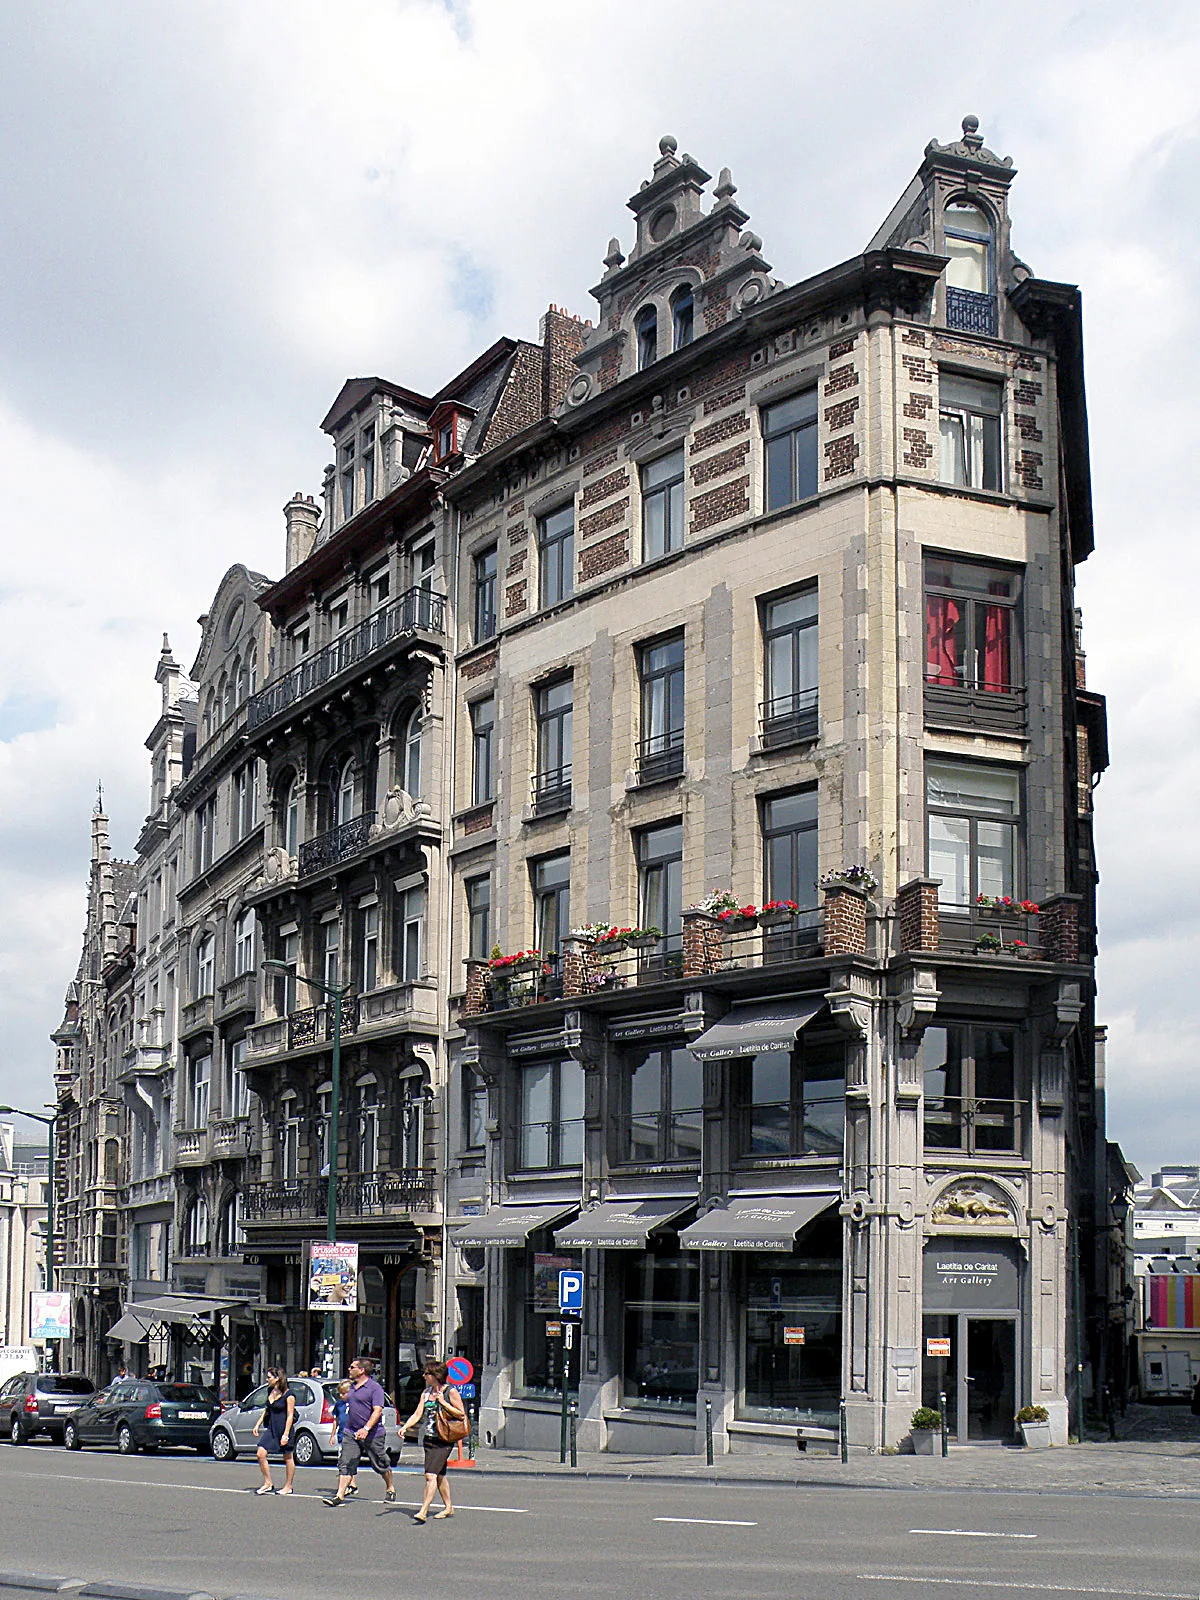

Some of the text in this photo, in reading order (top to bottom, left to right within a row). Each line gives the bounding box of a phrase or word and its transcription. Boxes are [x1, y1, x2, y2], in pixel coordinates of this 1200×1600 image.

[710, 1049, 735, 1057] Gallery
[770, 1042, 790, 1050] Caritat
[573, 1239, 593, 1247] Gallery
[702, 1240, 728, 1248] Gallery
[734, 1239, 754, 1247] Laetitia
[764, 1240, 784, 1248] Caritat
[313, 1246, 356, 1254] Brussels Card
[285, 1255, 294, 1265] LA
[936, 1262, 998, 1271] Laetitia de Caritat
[942, 1276, 992, 1287] Art Gallery
[563, 1276, 580, 1303] P
